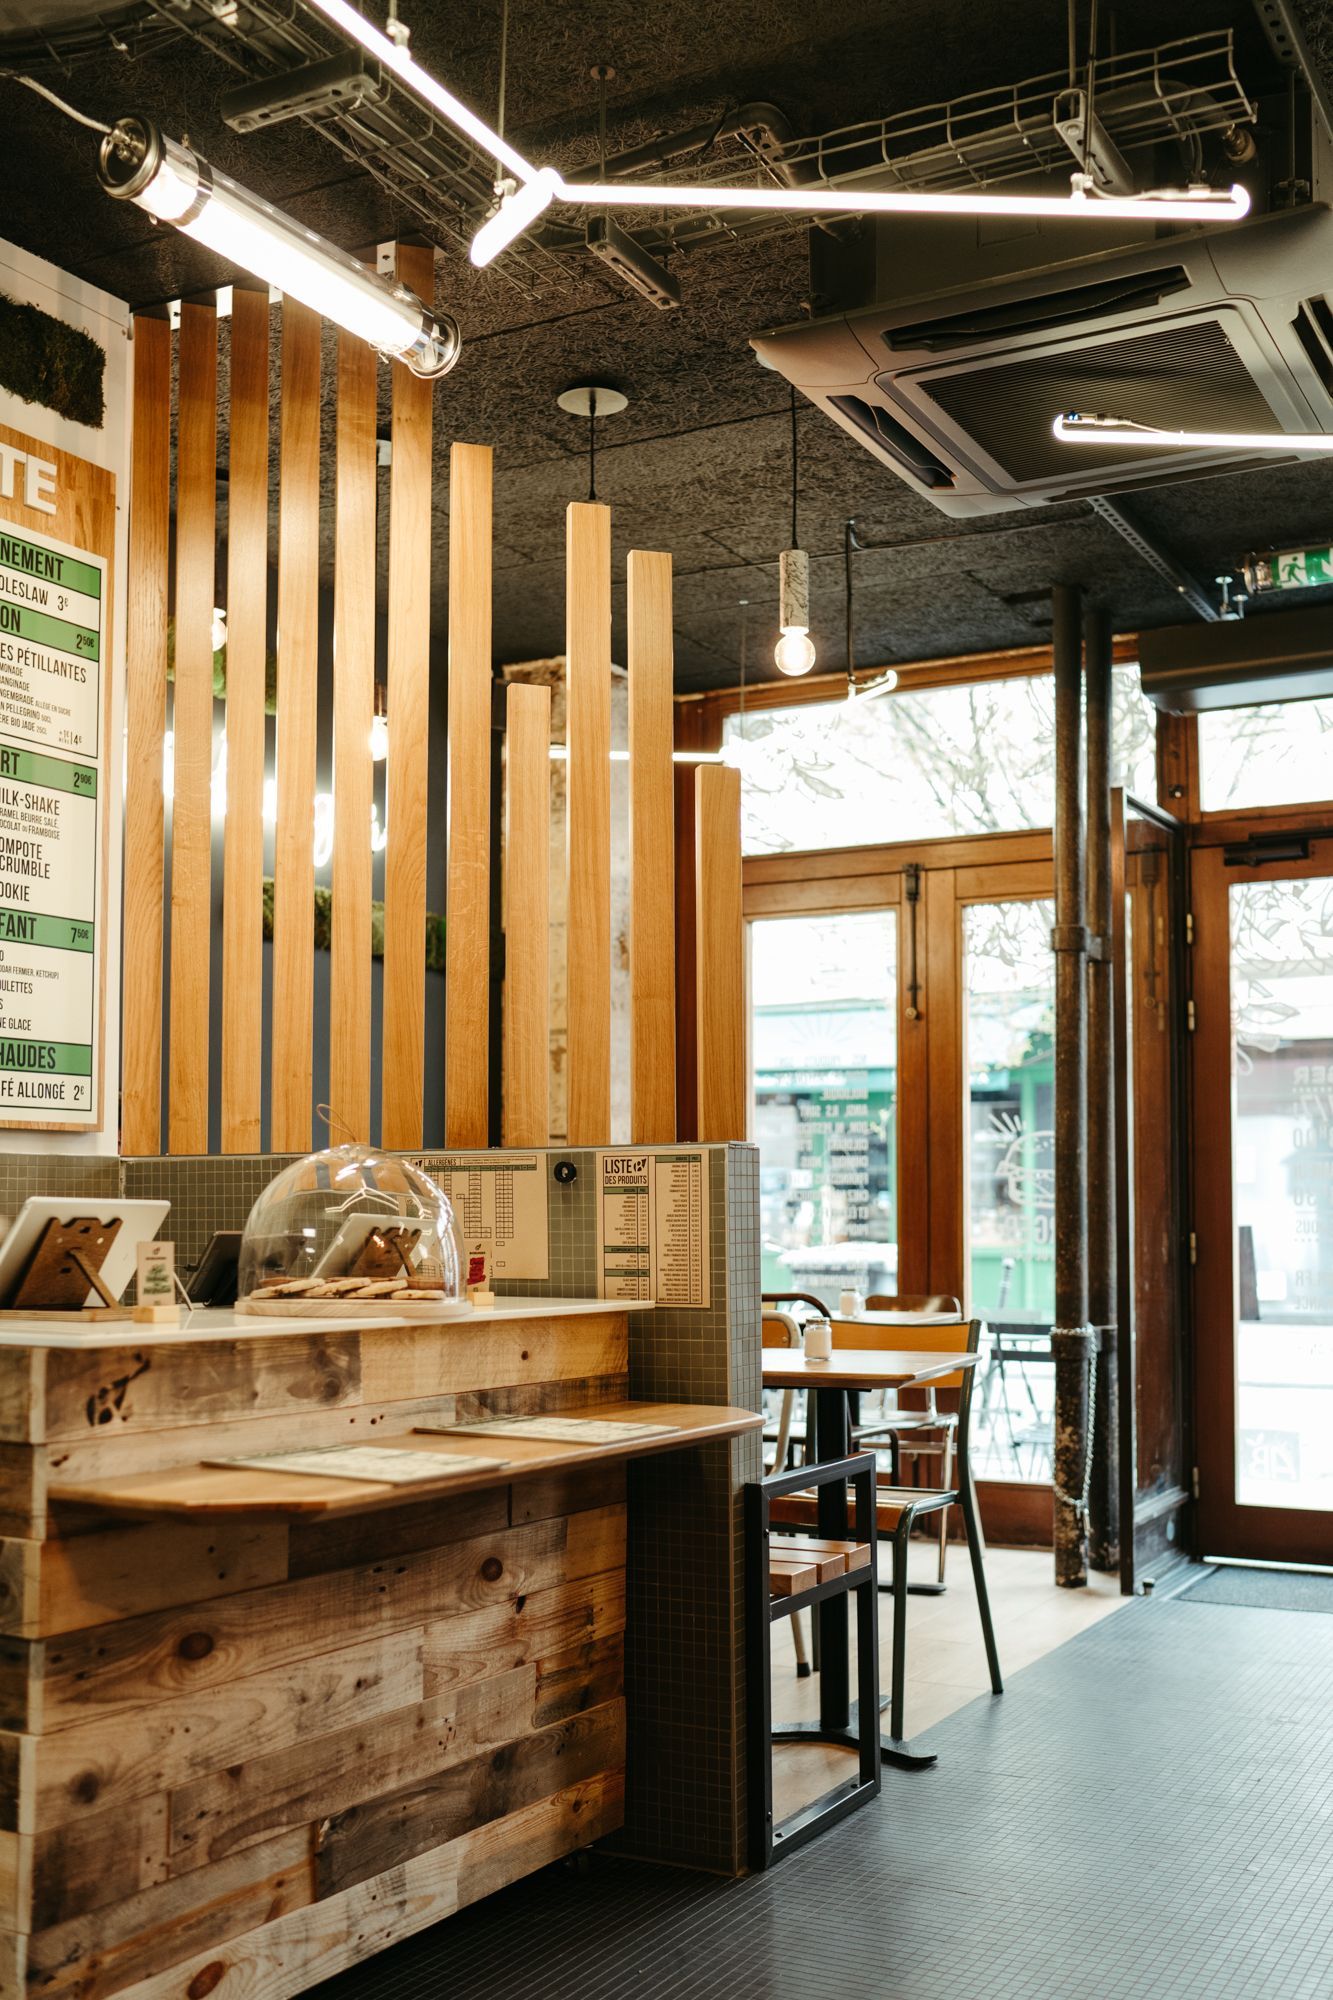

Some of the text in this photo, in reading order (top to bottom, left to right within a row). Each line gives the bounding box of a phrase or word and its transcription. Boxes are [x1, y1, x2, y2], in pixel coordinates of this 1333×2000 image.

[0, 537, 64, 582] NEMENT
[0, 605, 21, 633] ON
[0, 643, 87, 683] ES PÉTILLANTES
[6, 702, 41, 721] PELLEGRINO
[1, 750, 20, 775] RT
[0, 786, 60, 816] ILK-SHAKE
[0, 854, 51, 880] CRUMBLE
[0, 979, 33, 995] ULETTES
[8, 1017, 32, 1031] GLACE
[1, 1077, 15, 1097] FÉ
[17, 1081, 66, 1100] ALLONGÉ
[605, 1159, 632, 1174] LISTE
[604, 1175, 647, 1185] DES PRODUITS
